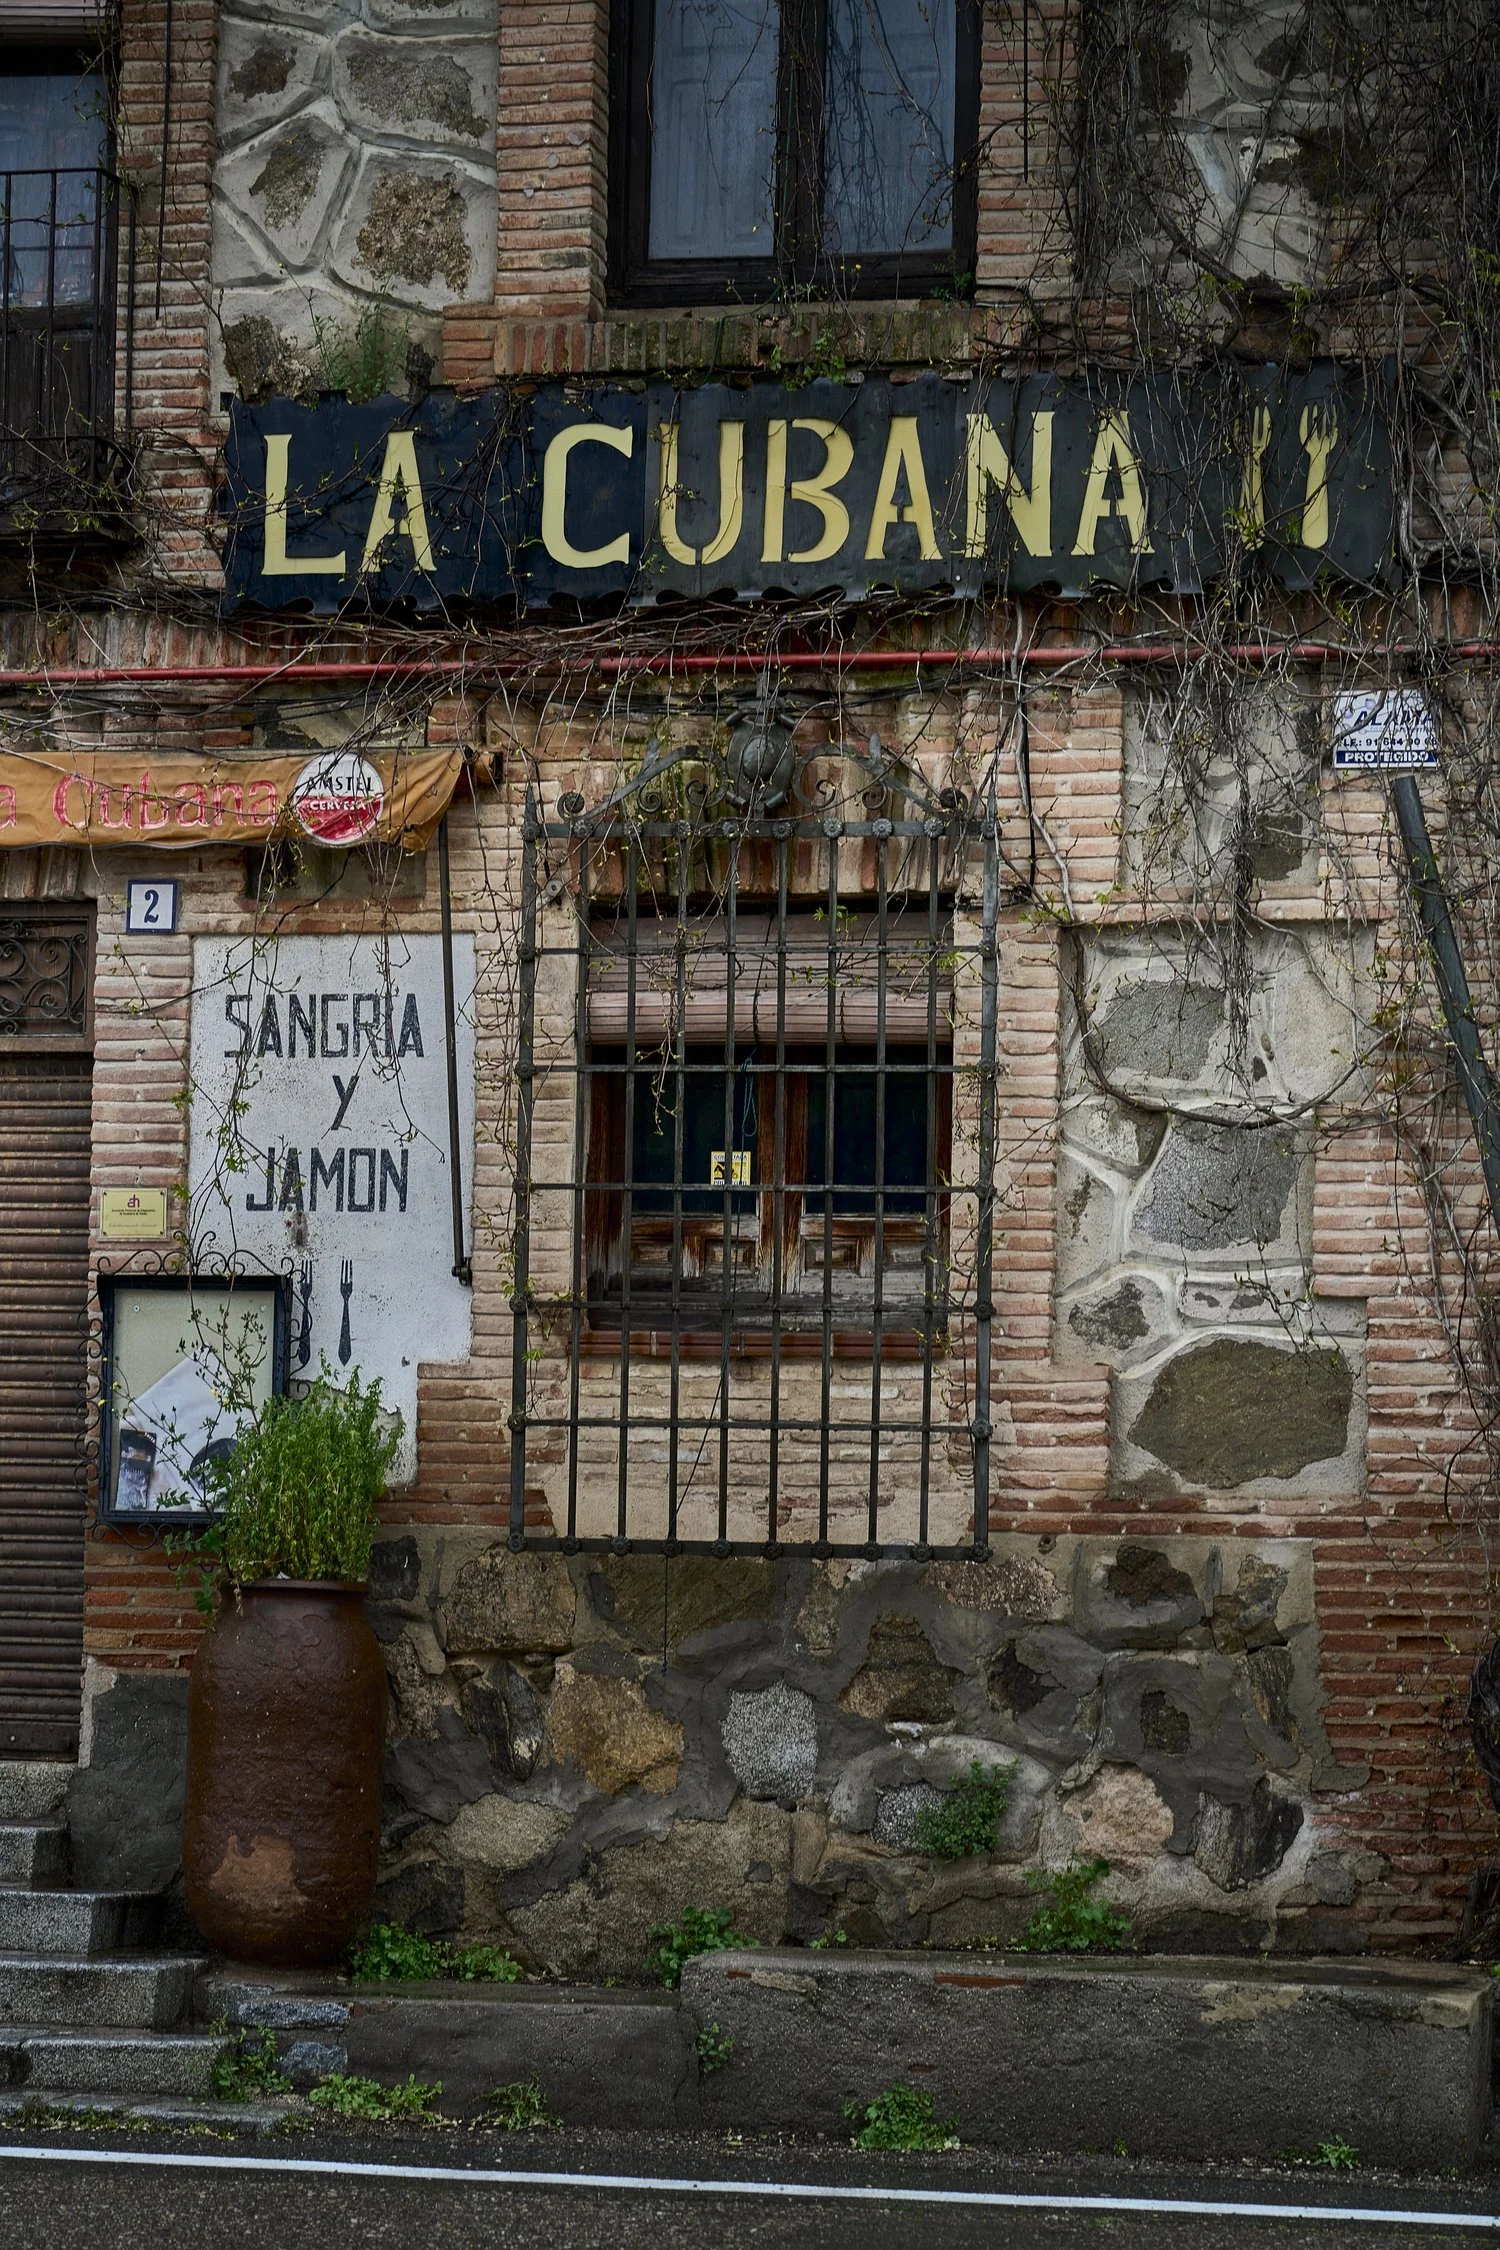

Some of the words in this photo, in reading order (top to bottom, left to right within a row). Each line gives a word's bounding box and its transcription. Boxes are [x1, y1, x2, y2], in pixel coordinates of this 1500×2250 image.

[261, 429, 437, 575] LA
[541, 410, 1155, 569] CUBANA
[306, 776, 375, 792] AMSTEL
[1344, 751, 1430, 763] PROTEGIDO
[53, 771, 279, 830] Cubana
[143, 889, 160, 924] 2
[224, 993, 425, 1058] SANGRIA
[245, 1147, 409, 1212] JAMON
